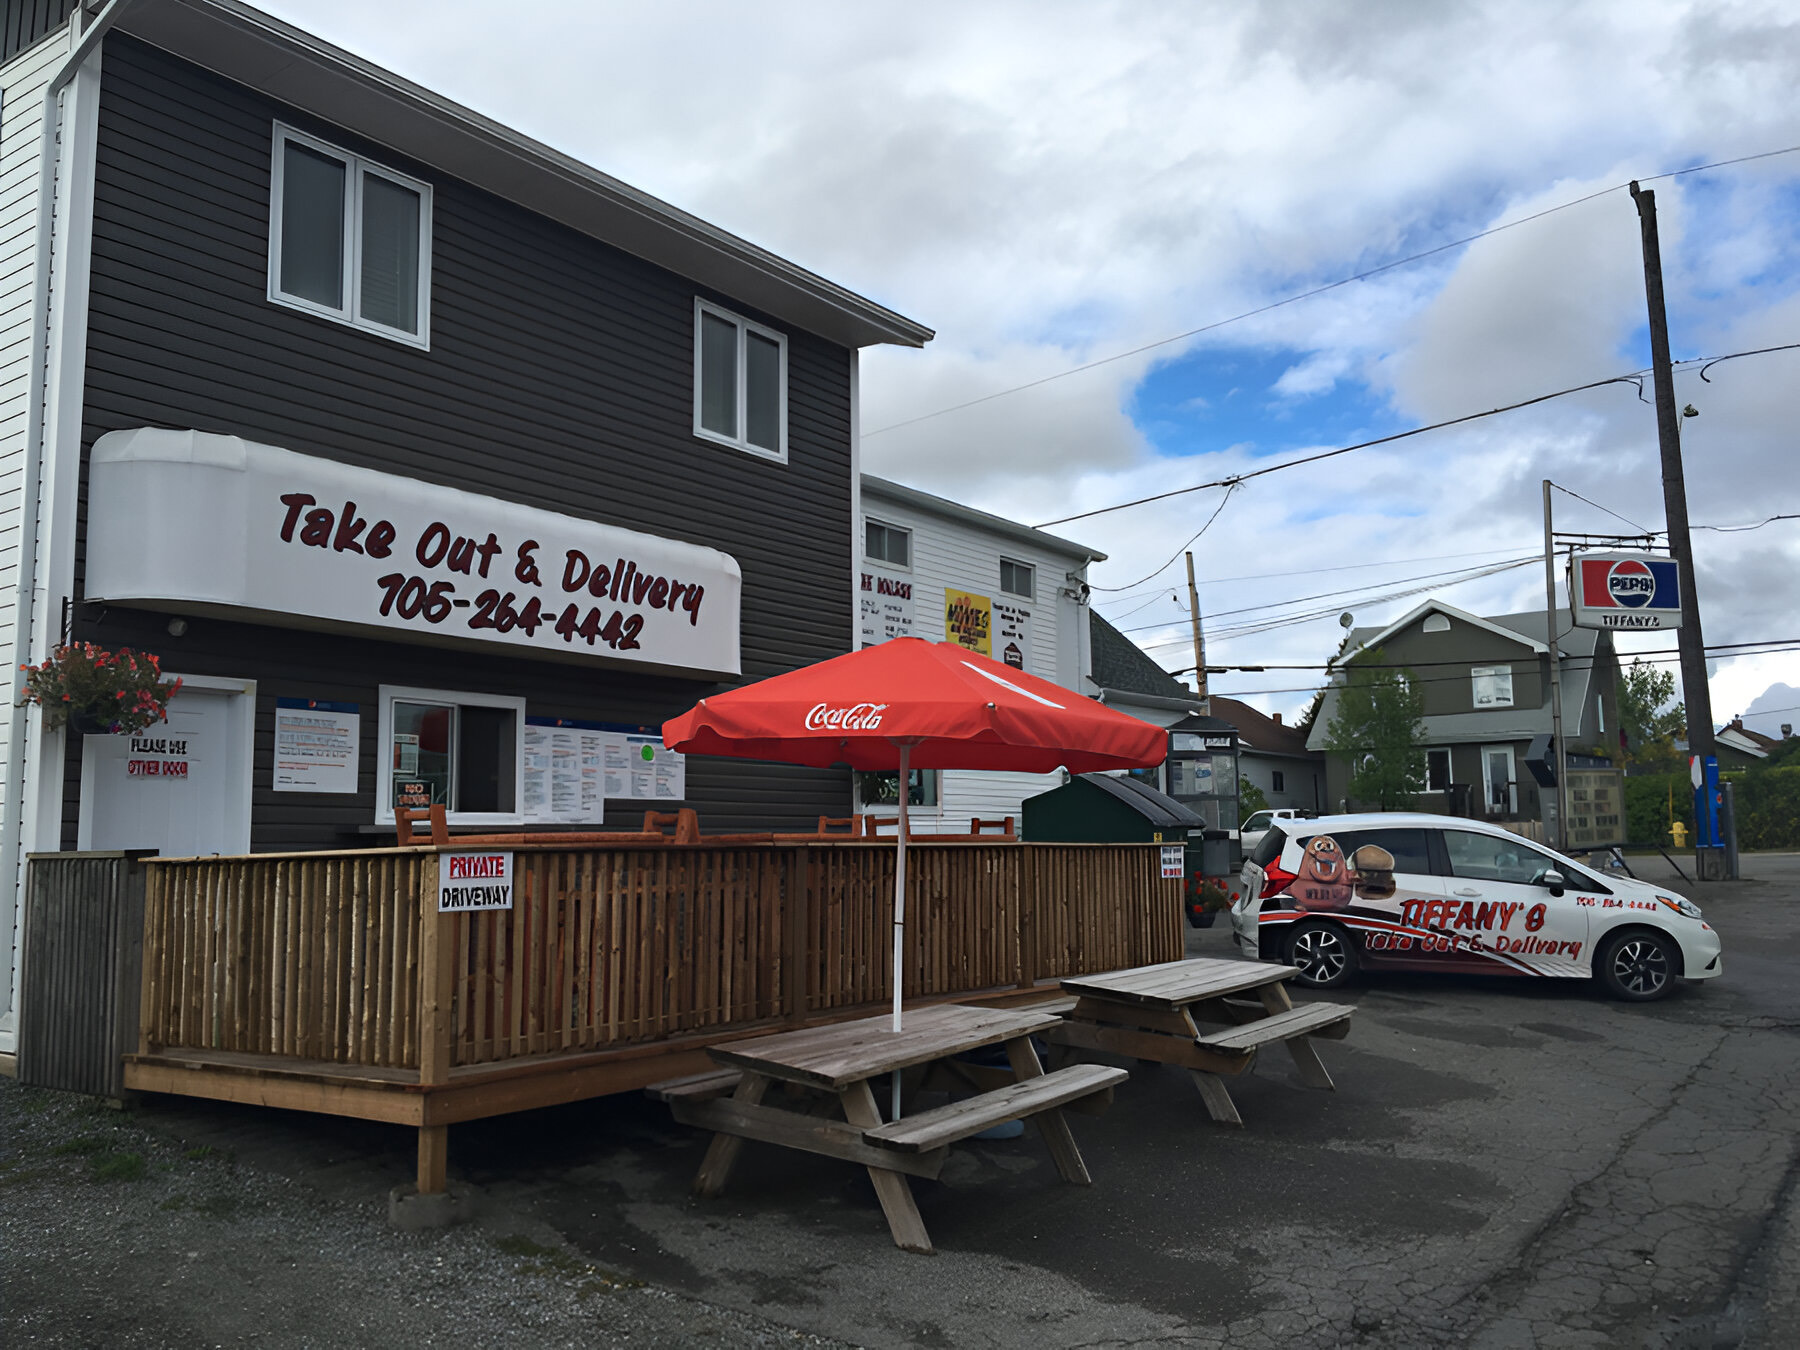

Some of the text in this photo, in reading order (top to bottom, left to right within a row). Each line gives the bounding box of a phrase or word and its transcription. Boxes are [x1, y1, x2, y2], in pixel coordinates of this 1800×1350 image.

[280, 493, 704, 627] Take Out & Delivery
[377, 573, 644, 650] 705-264-4442
[449, 856, 505, 879] PRIVATE
[441, 885, 510, 908] DRIVEWAY
[1496, 935, 1583, 960] Delivery
